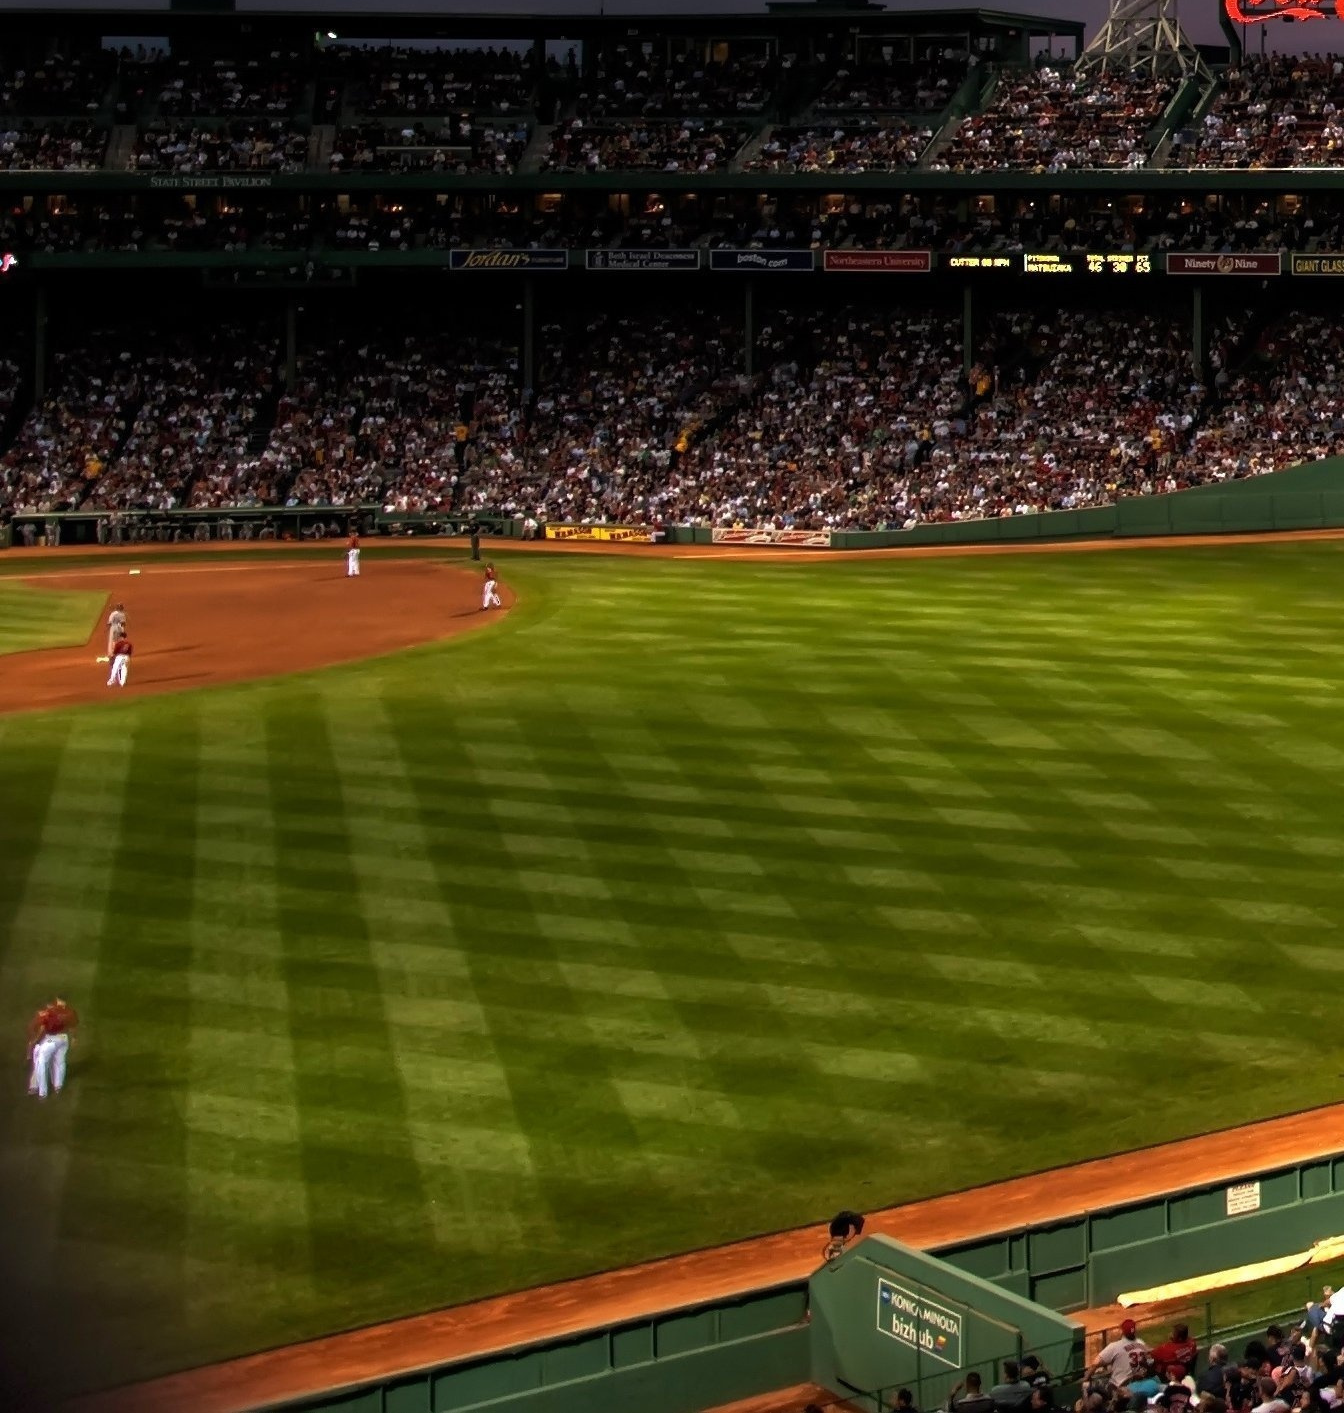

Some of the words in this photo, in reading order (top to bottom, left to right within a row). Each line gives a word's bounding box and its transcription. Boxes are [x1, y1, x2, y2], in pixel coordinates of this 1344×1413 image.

[1185, 259, 1216, 270] Ninety
[1234, 259, 1258, 269] Nine
[1296, 260, 1319, 272] GIANT
[892, 1313, 934, 1350] bizhub
[923, 1309, 960, 1337] MINOLTA
